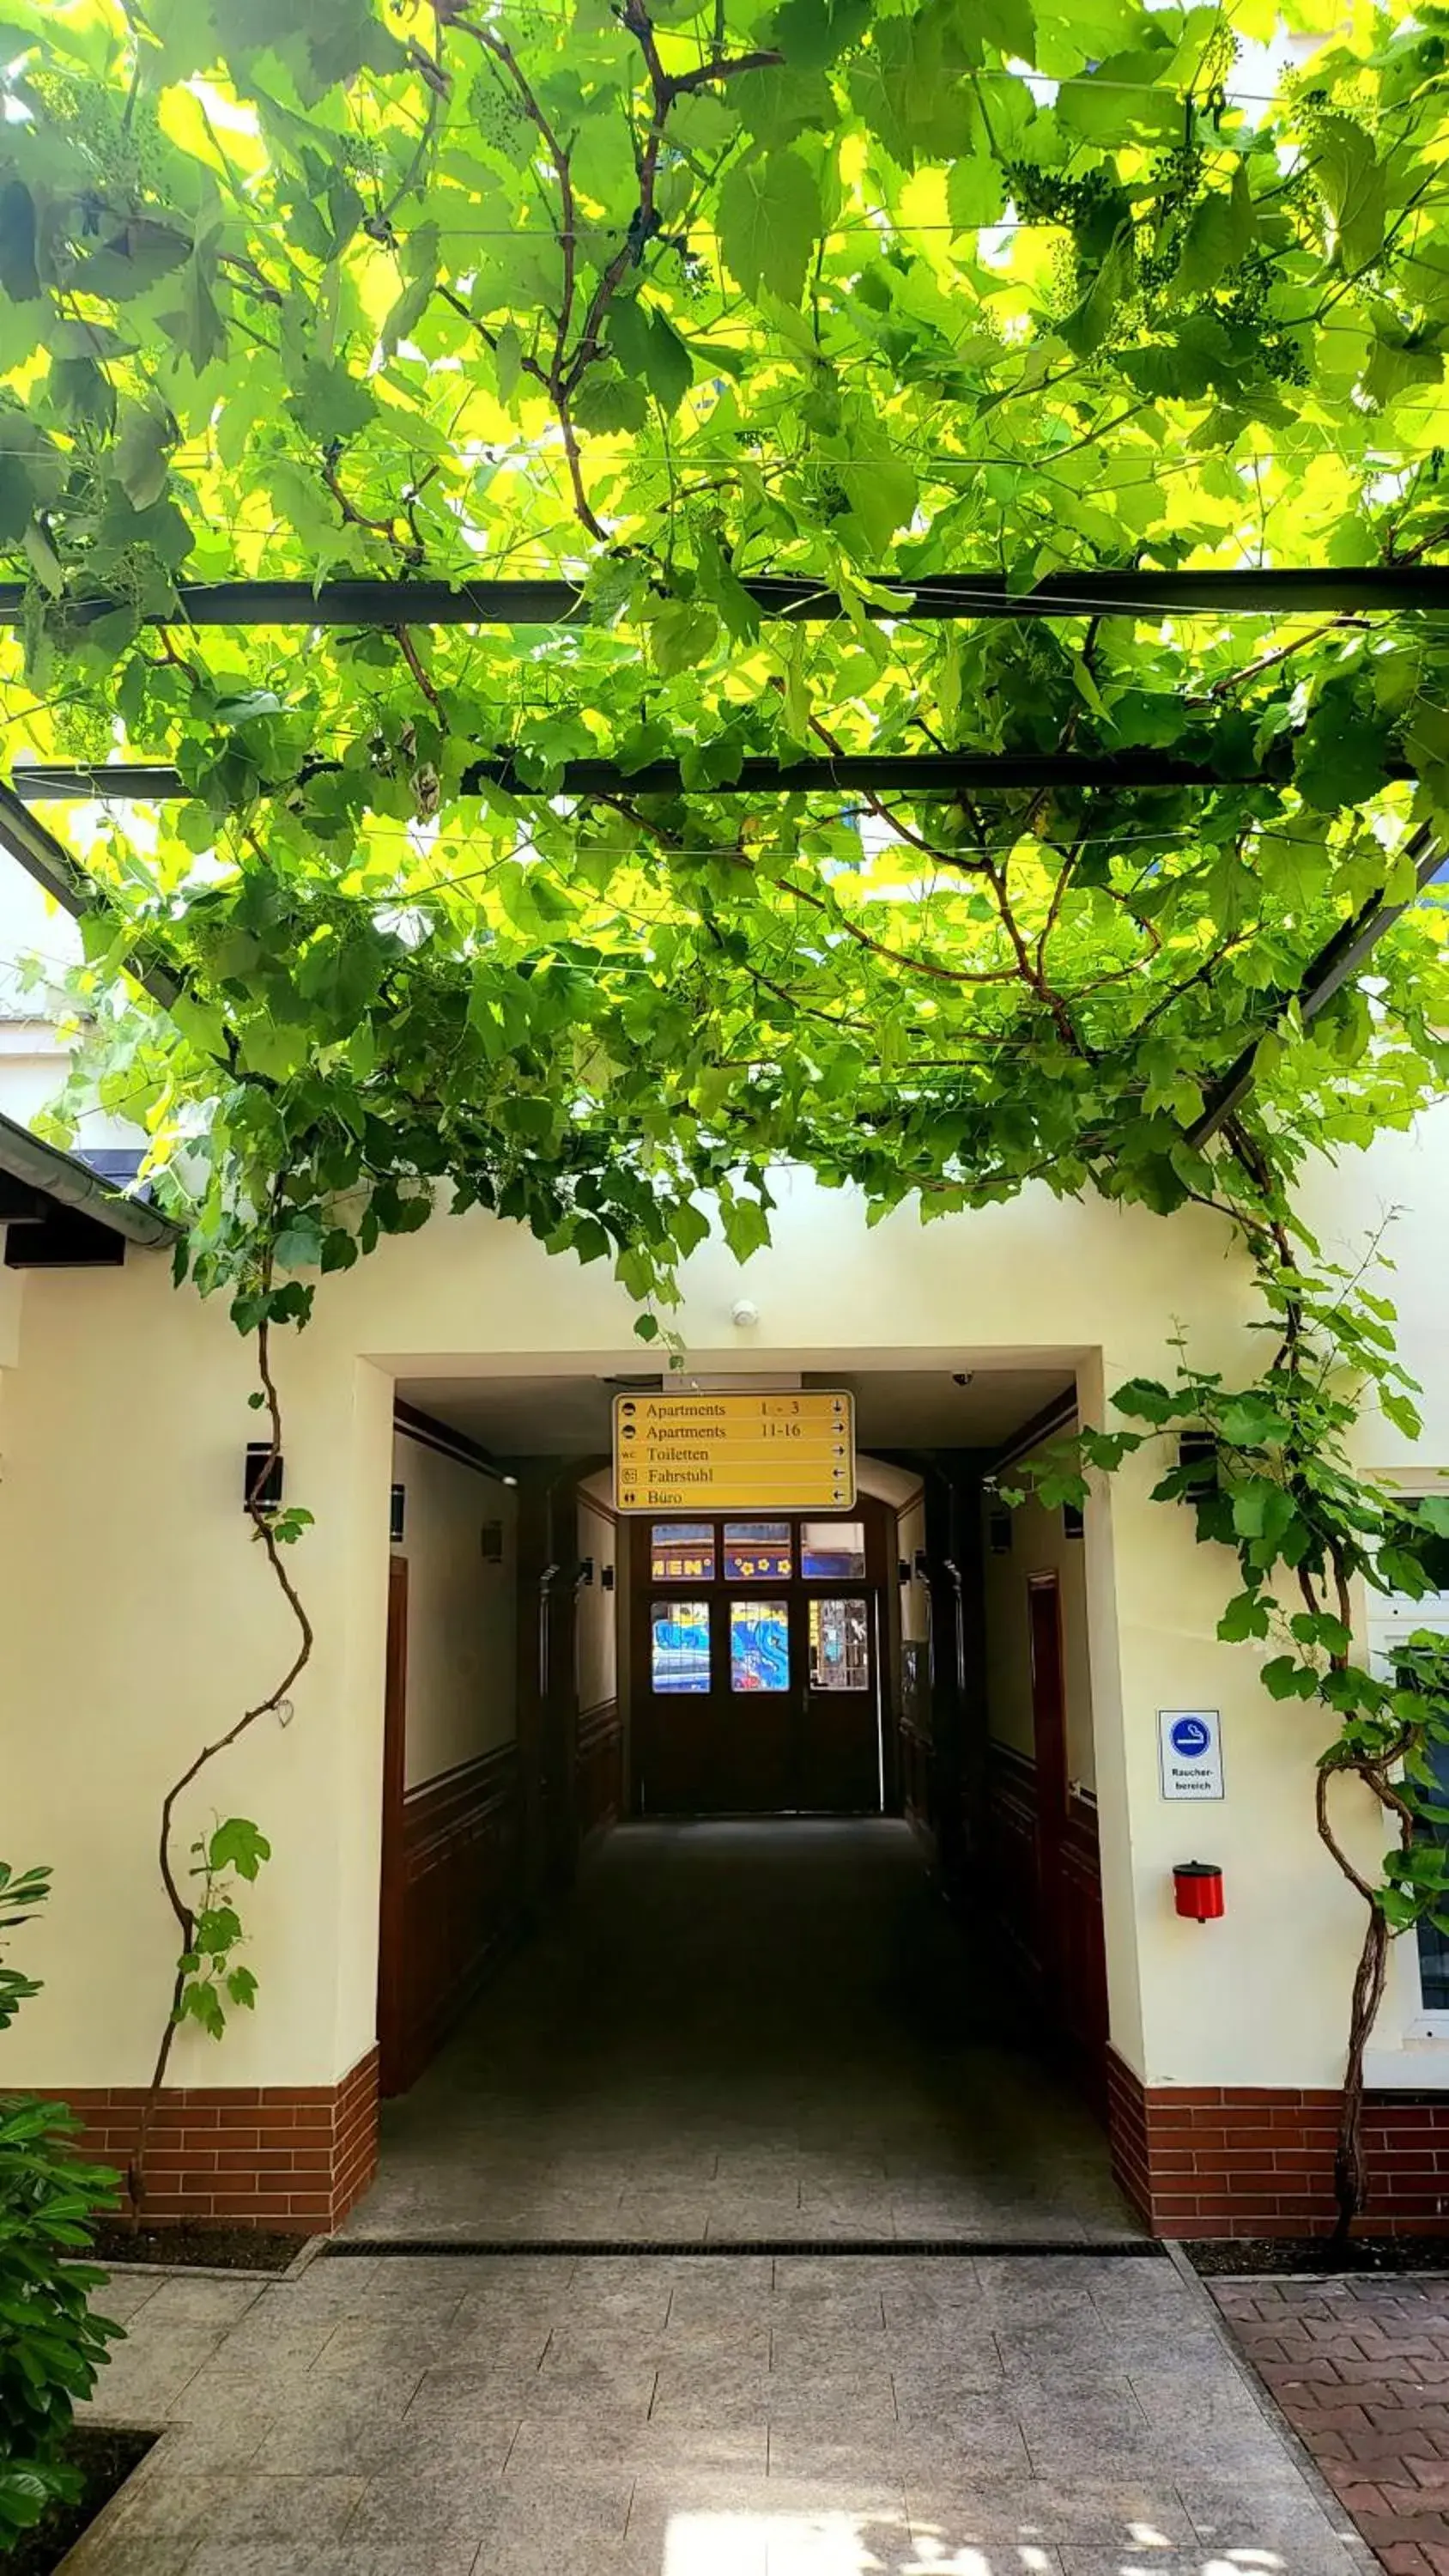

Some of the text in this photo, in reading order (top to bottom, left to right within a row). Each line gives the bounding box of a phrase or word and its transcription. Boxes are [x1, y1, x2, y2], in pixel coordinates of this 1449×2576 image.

[646, 1403, 726, 1419] Apartments
[761, 1402, 767, 1414] 1
[791, 1402, 800, 1414] 3
[646, 1425, 801, 1441] Apartments 11-16
[646, 1448, 709, 1461] Toiletten
[647, 1468, 713, 1482] Fahrstuhl
[647, 1491, 682, 1504] Büro
[1172, 1768, 1215, 1777] Raucher-
